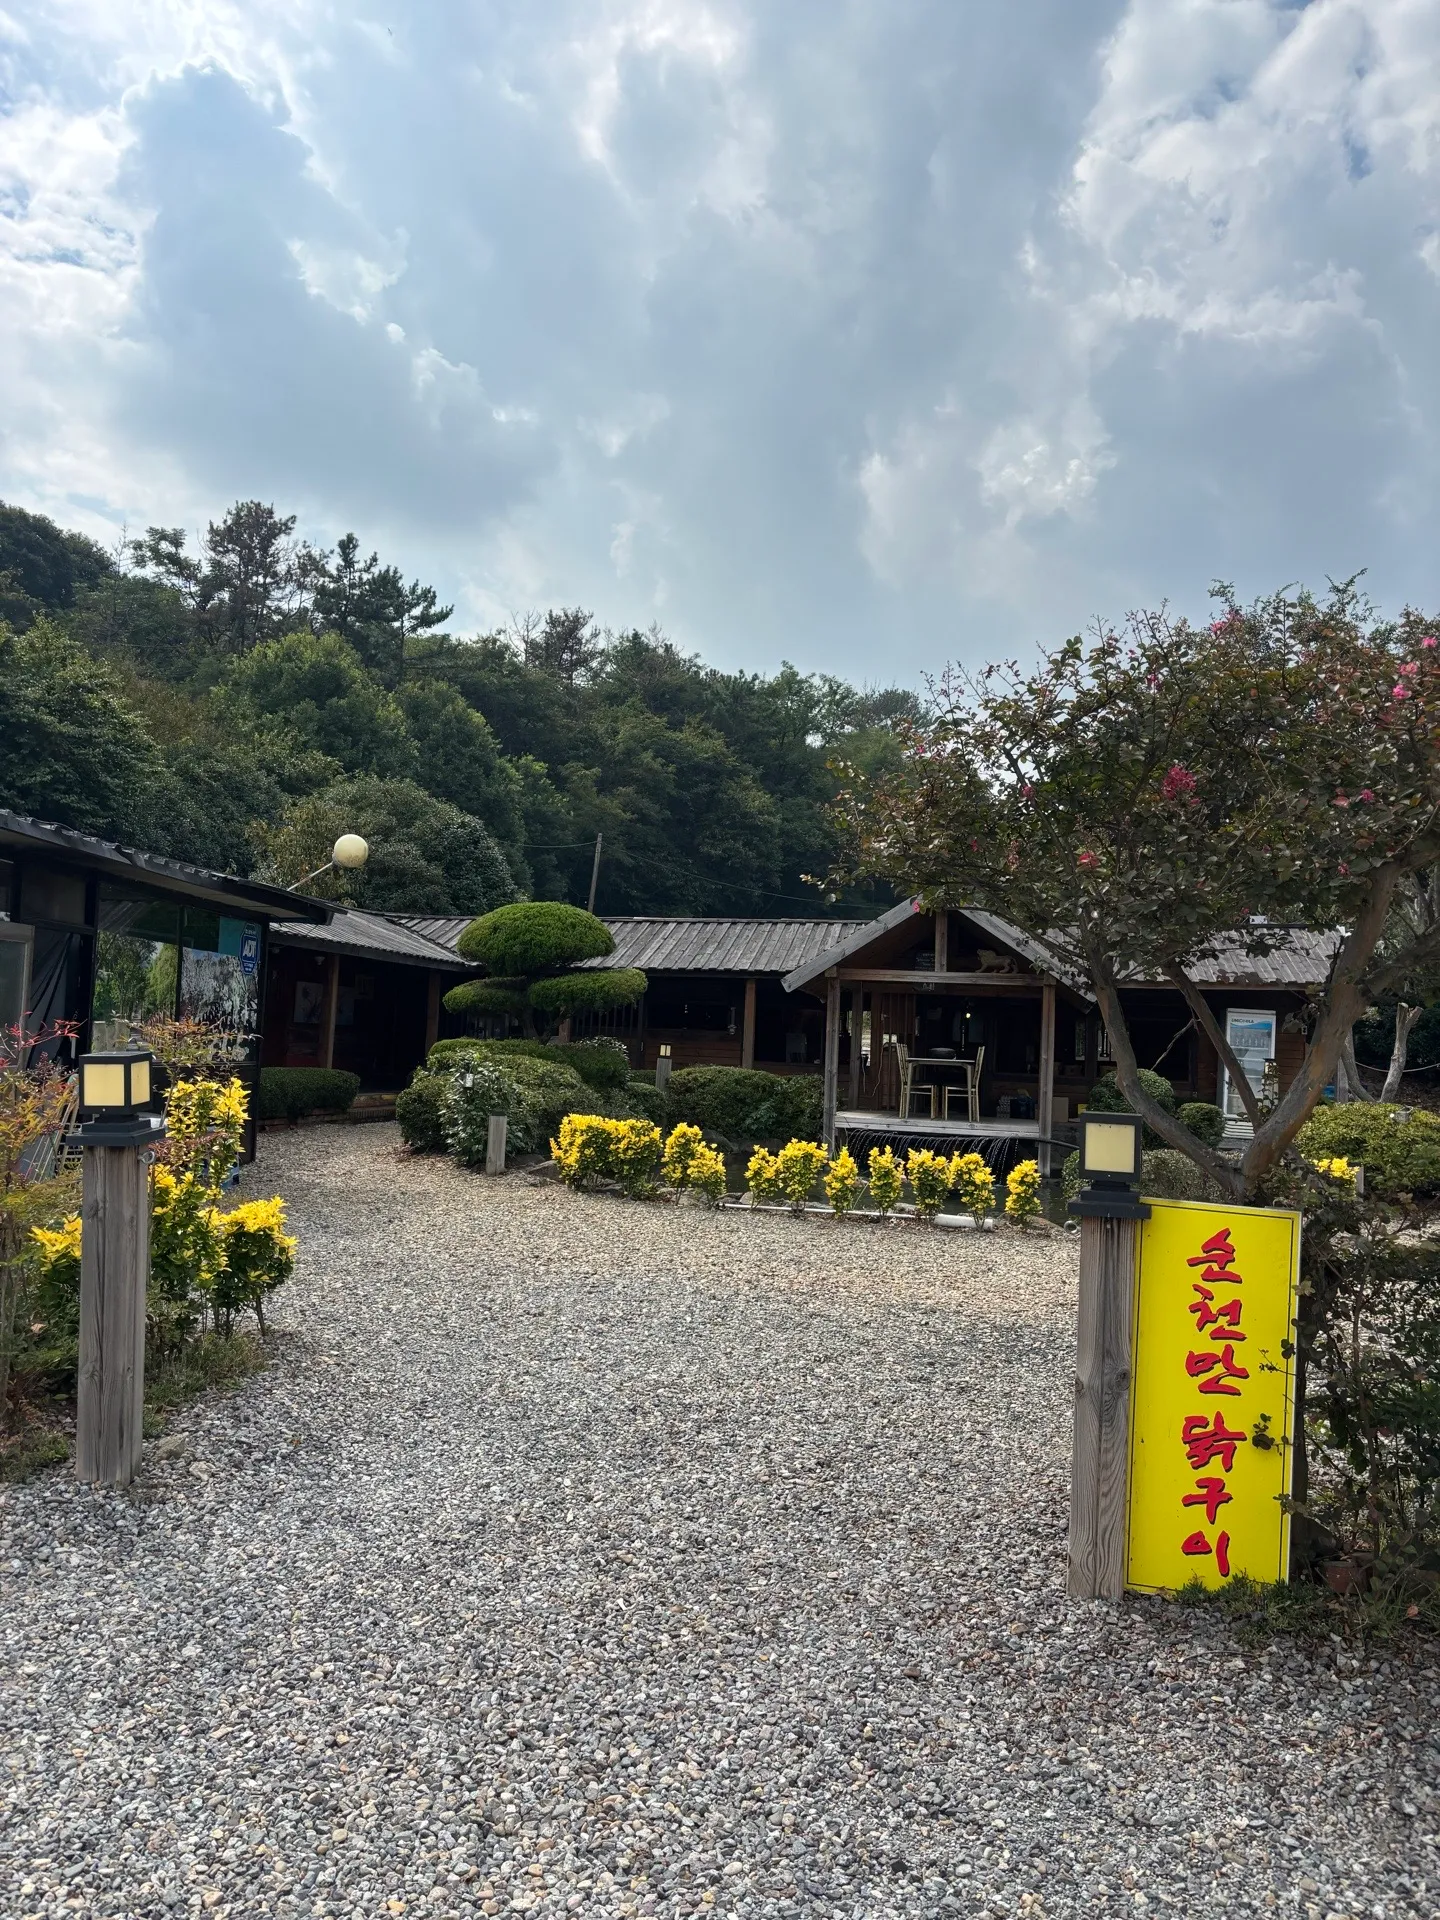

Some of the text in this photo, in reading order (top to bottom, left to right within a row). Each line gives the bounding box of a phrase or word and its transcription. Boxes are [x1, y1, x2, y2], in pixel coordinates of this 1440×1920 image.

[243, 939, 257, 957] ADT
[1181, 1227, 1250, 1578] 순천만 닭구이
